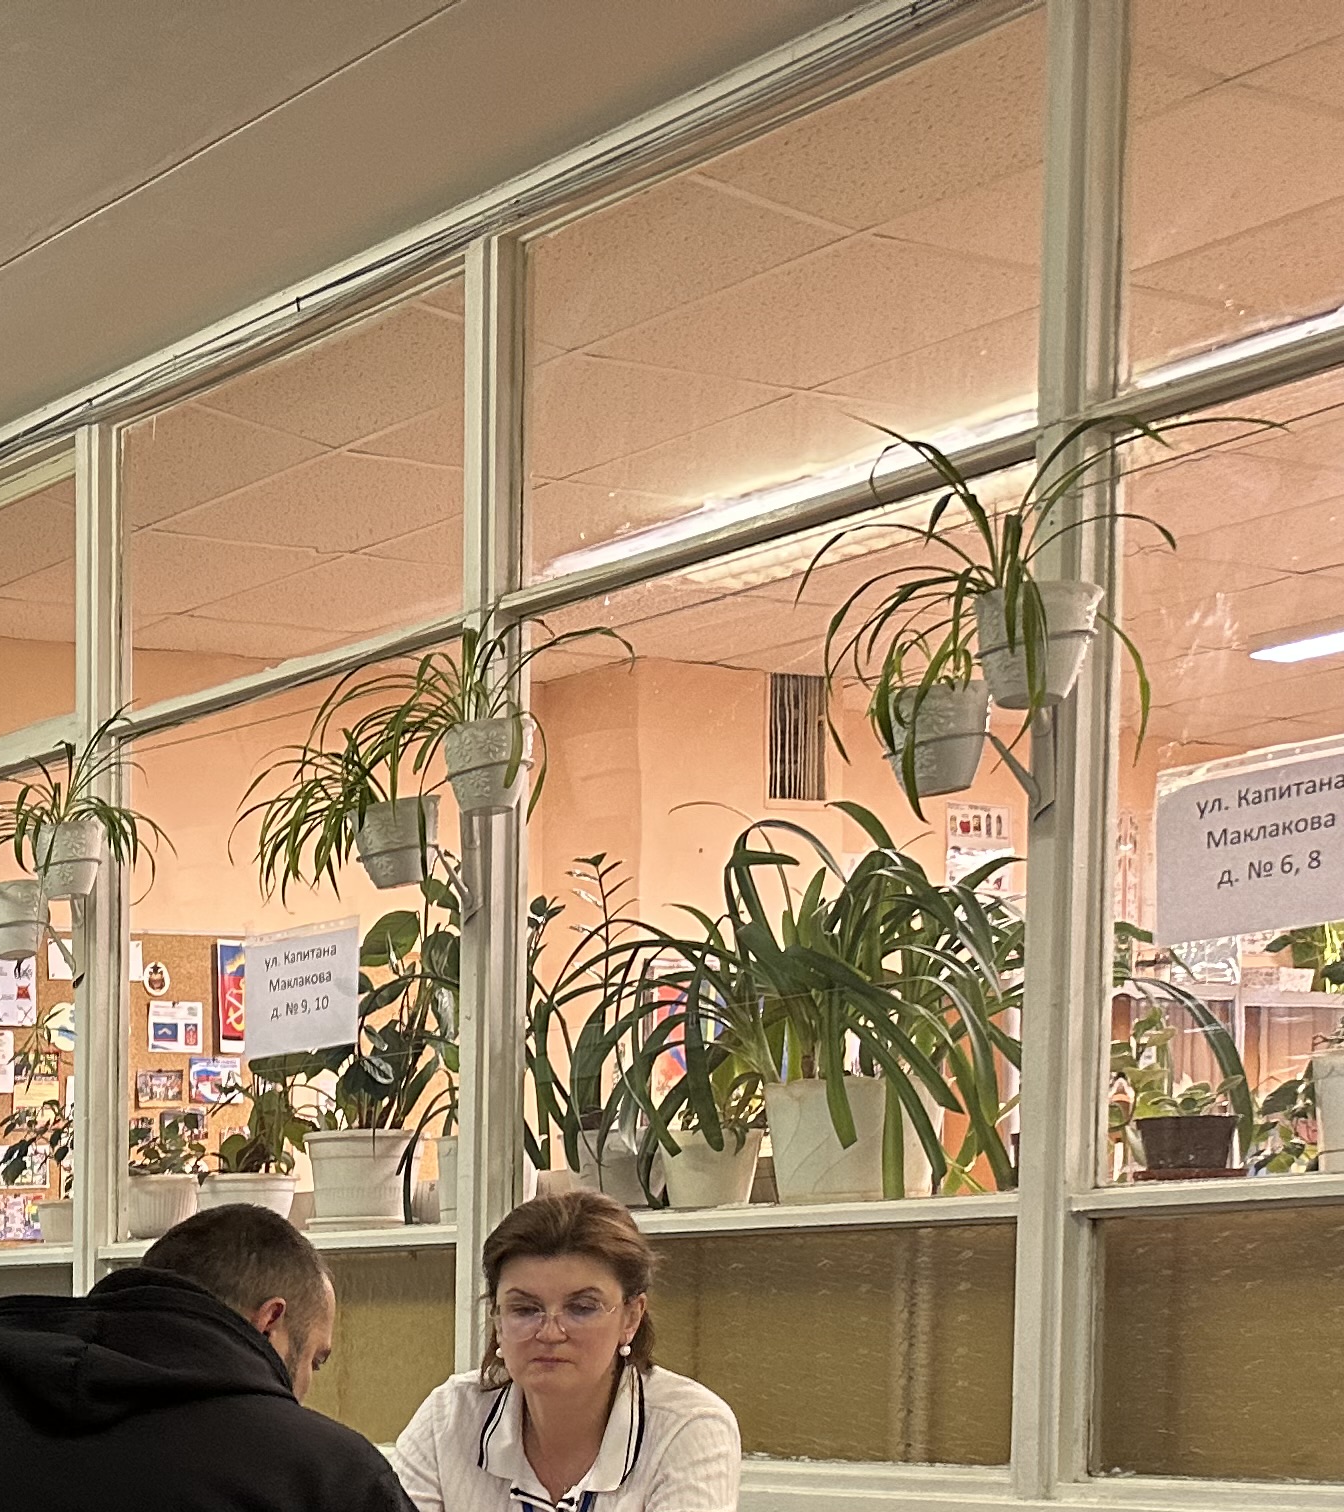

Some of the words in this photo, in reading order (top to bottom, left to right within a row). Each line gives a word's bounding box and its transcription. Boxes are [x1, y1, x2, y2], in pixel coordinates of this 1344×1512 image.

[1196, 797, 1229, 819] ул.
[1237, 773, 1344, 808] Капитана
[1206, 812, 1336, 849] Маклакова
[1217, 869, 1240, 889] д.
[1248, 860, 1273, 880] №
[1280, 854, 1300, 876] 6,
[1307, 849, 1322, 869] 8
[265, 956, 281, 972] ул.
[284, 944, 337, 965] Капитана
[269, 970, 332, 992] Маклакова
[271, 1007, 282, 1021] д.
[285, 1001, 299, 1016] №
[301, 999, 311, 1015] 9,
[315, 995, 329, 1011] 10
